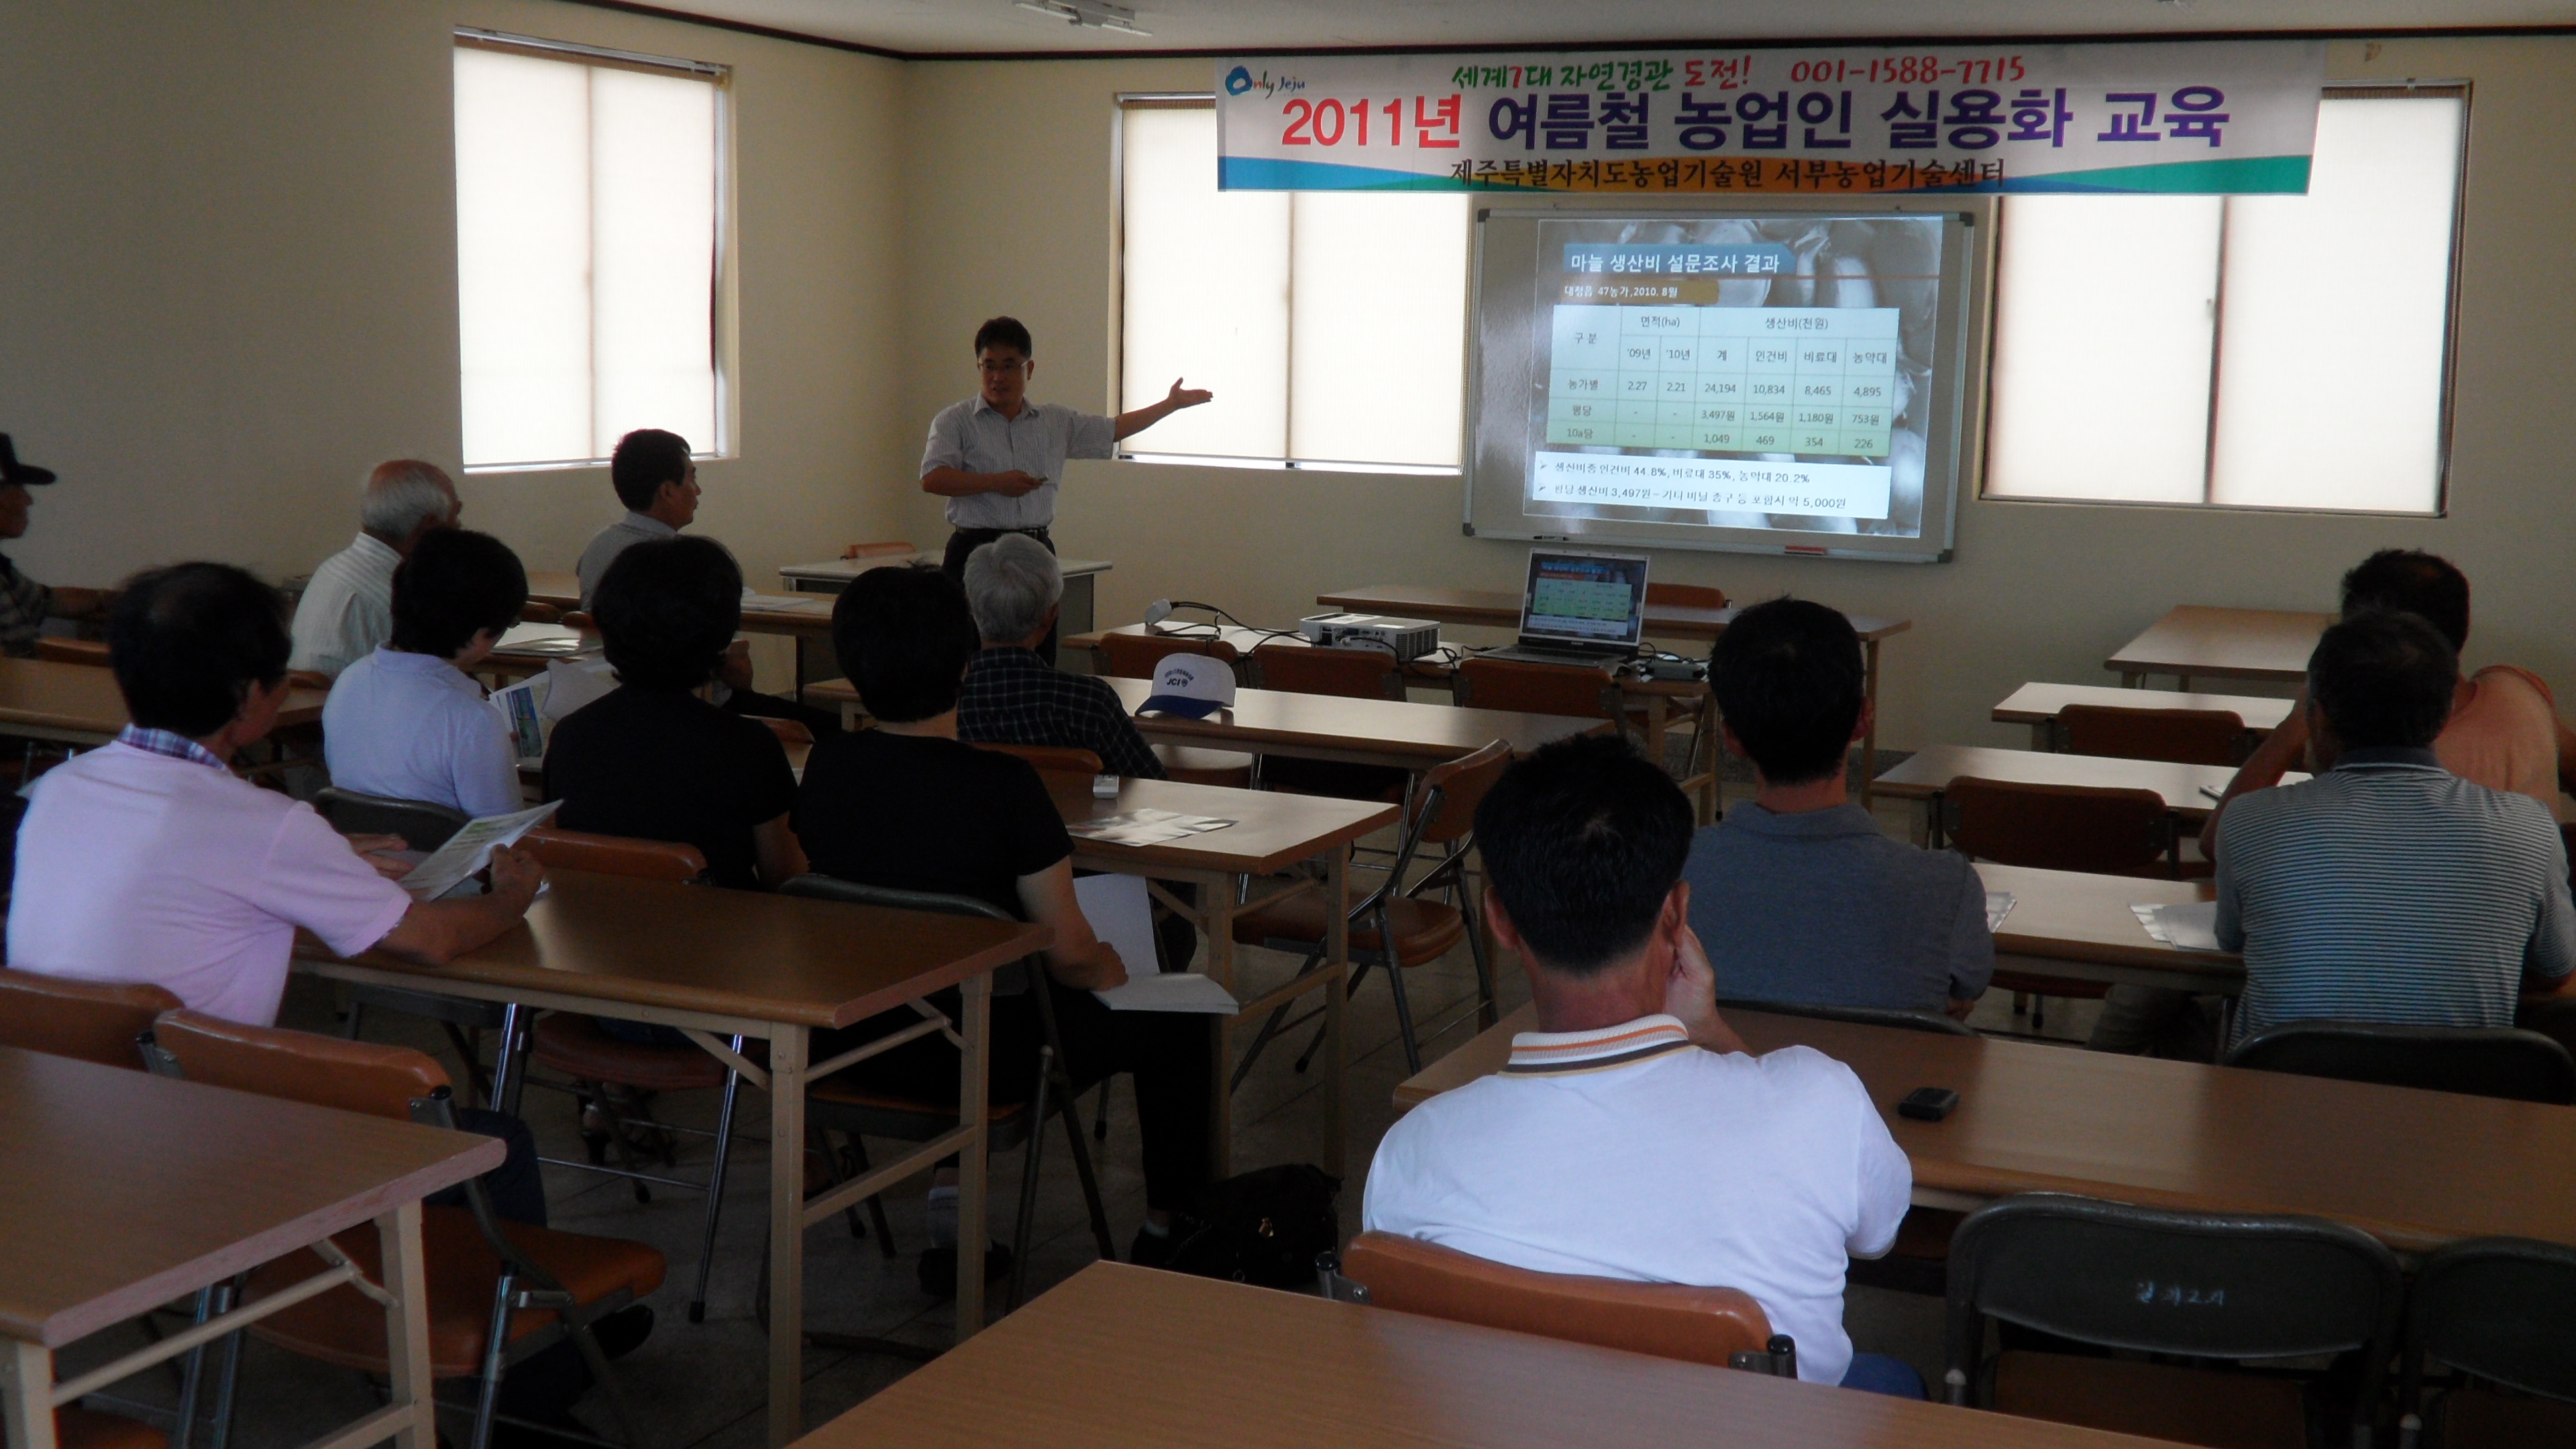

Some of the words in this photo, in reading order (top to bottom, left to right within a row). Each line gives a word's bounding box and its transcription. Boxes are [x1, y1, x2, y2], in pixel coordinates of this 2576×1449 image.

[1451, 64, 1554, 91] 세계7대
[1560, 61, 1674, 92] 자연경관
[1684, 54, 1752, 90] 도전!
[1790, 54, 2026, 85] 001-1588-7715
[1225, 65, 1274, 99] Only
[1277, 76, 1305, 92] Jeju
[1282, 93, 1462, 150] 2011년
[1488, 91, 1650, 150] 여름철
[1674, 89, 1851, 149] 농업인
[1881, 87, 2073, 150] 실용화
[2097, 86, 2230, 149] 교육
[1450, 156, 1762, 189] 제주특별자치도농업기술원
[1776, 158, 2005, 189] 서부농업기술센터
[1571, 254, 1603, 272] 마늘
[1611, 254, 1660, 272] 생산비
[1668, 254, 1737, 273] 설문조사
[1744, 254, 1780, 273] 결과
[1662, 286, 1678, 299] 8월
[1641, 315, 1680, 327] 면적(ha)
[1717, 350, 1727, 361] 계
[1756, 350, 1787, 362] 인건비
[1805, 351, 1837, 363] 비료대
[1854, 352, 1887, 364] 농약대
[1628, 380, 1647, 391] 2.27
[1667, 382, 1685, 392] 2.21
[1705, 383, 1735, 394] 24,194
[1754, 384, 1785, 395] 10,834
[1805, 386, 1831, 396] 8,465
[1854, 386, 1881, 397] 4,895
[1702, 410, 1735, 421] 3,497원
[1750, 411, 1784, 423] 1,564원
[1799, 413, 1833, 424] 1,180원
[1852, 414, 1879, 425] 753원
[1704, 433, 1730, 444] 1,049
[1756, 435, 1774, 445] 469
[1806, 437, 1823, 447] 354
[1854, 439, 1873, 449] 226
[1775, 472, 1810, 483] 20.2%
[1167, 678, 1181, 686] JCI
